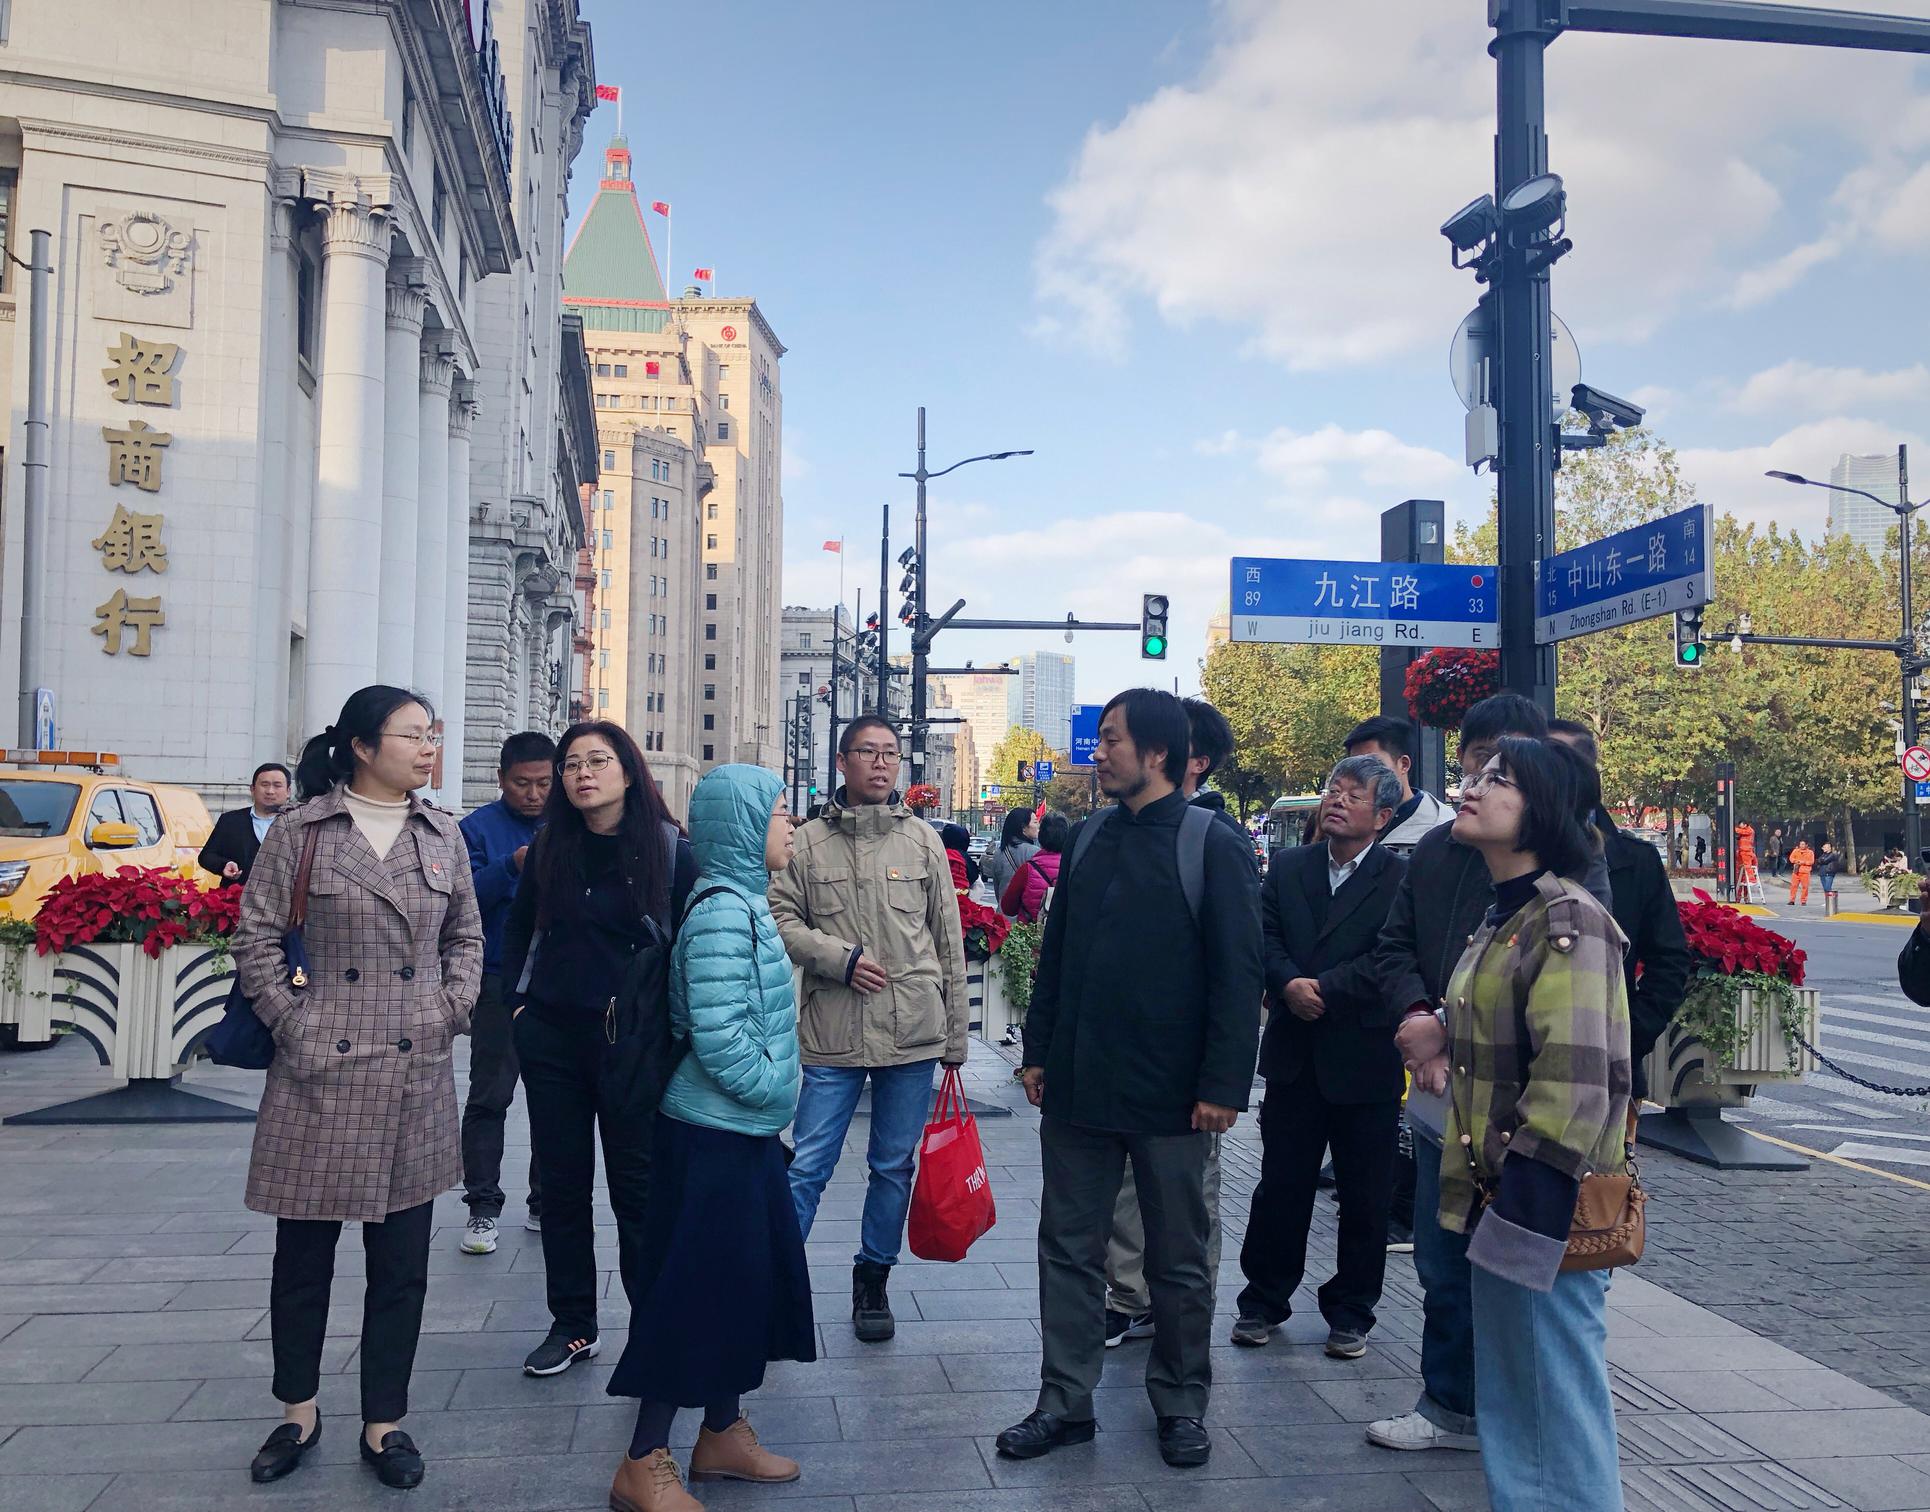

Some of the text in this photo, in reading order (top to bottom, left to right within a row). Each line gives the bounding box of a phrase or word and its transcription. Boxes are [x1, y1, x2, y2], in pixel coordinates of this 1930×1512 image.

[91, 331, 178, 656] 招商銀行
[1683, 519, 1696, 540] 南
[1568, 531, 1667, 598] 中山东一路
[1684, 549, 1696, 566] 14
[1245, 566, 1262, 584] 西
[1546, 566, 1557, 583] 北
[1244, 590, 1261, 607] 89
[1313, 571, 1420, 610] 九江路
[1686, 581, 1695, 599] S
[1468, 598, 1484, 614] 33
[1547, 591, 1557, 607] 15
[1569, 587, 1667, 631] Zhongshan Rd. (E-1)
[1247, 620, 1259, 637] W
[1308, 619, 1424, 641] jiu jiang Rd.
[1472, 627, 1482, 643] E
[1549, 621, 1556, 635] N
[1075, 737, 1100, 746] 河南中
